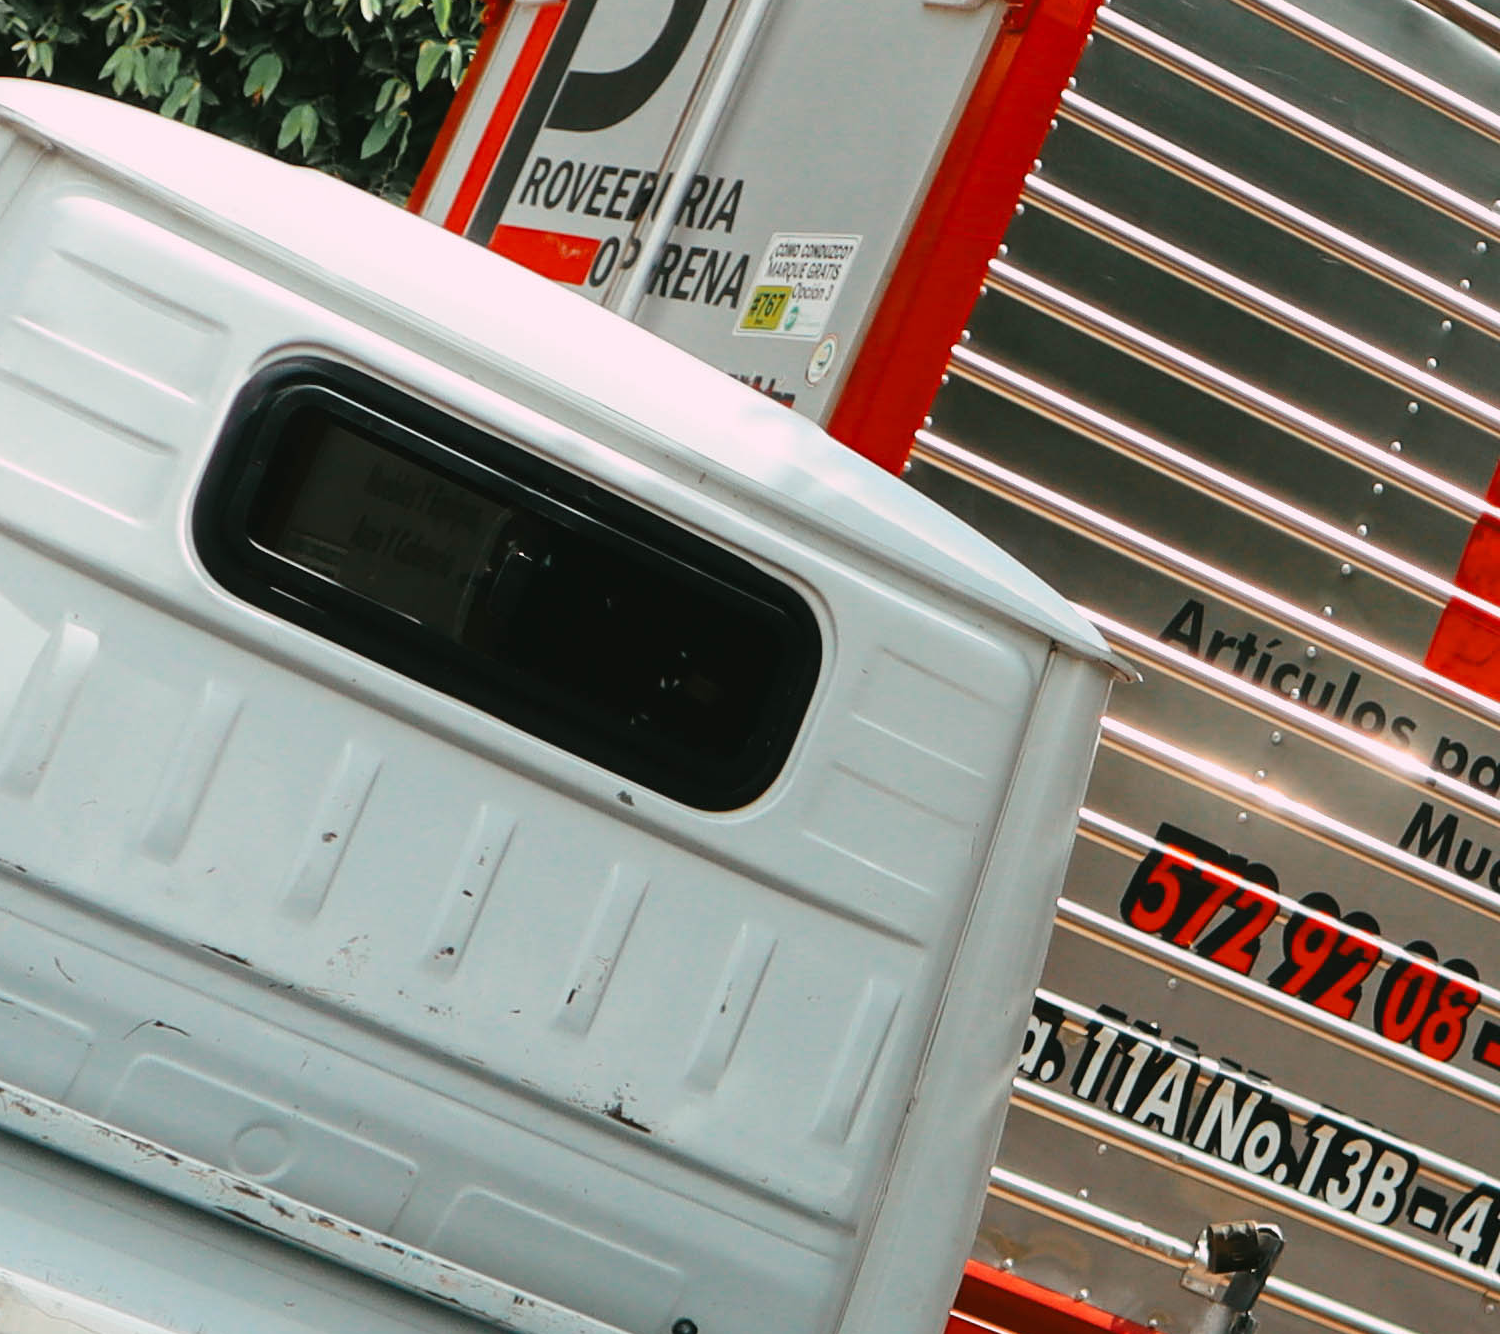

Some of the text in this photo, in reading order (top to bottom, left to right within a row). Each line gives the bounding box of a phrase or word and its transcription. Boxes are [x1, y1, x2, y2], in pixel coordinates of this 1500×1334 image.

[588, 236, 750, 309] OPRENA
[1158, 599, 1416, 747] Artículos
[1130, 842, 1278, 973] 572
[1281, 911, 1384, 1022] 92
[1380, 958, 1481, 1064] 08
